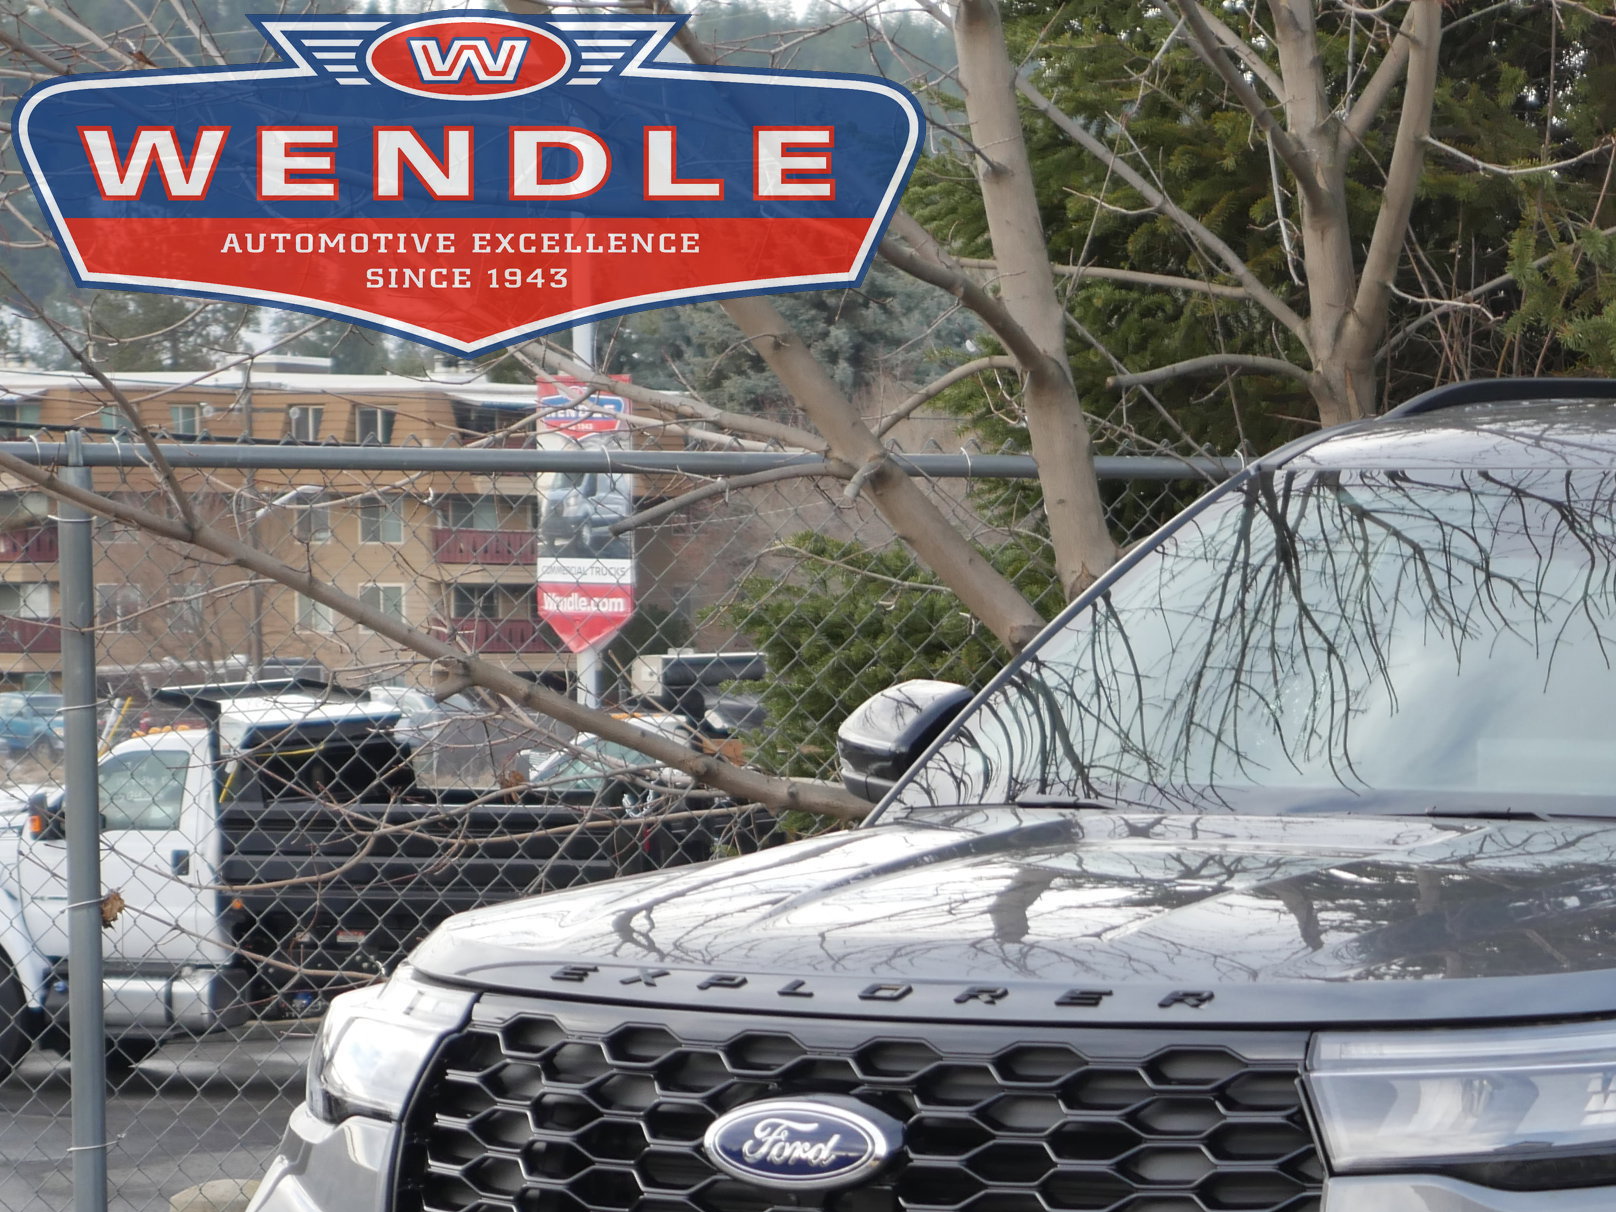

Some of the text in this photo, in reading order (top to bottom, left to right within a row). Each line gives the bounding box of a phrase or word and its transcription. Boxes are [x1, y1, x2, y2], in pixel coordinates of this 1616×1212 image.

[590, 566, 626, 577] TRUCKS
[550, 963, 1215, 1009] EXPLORER
[742, 1117, 840, 1168] Ford
